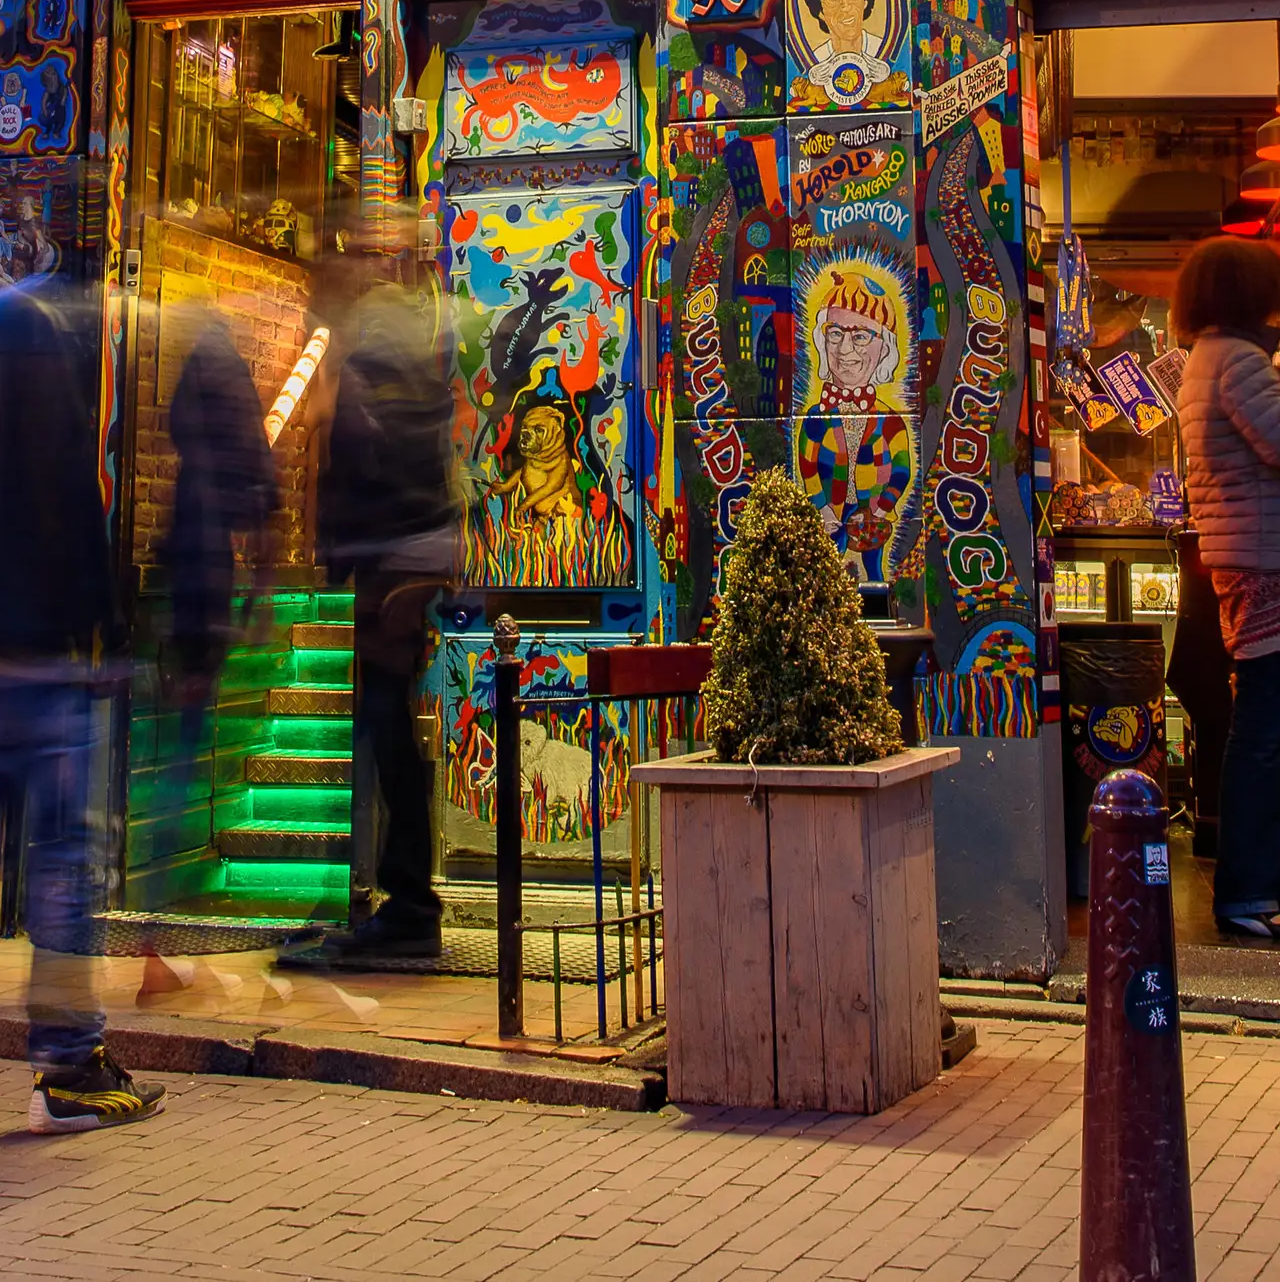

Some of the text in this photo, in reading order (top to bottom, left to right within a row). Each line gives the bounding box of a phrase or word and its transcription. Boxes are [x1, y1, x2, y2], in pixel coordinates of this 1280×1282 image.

[966, 69, 981, 86] This
[924, 97, 957, 114] PAINTED
[926, 102, 969, 141] AUSSIE
[800, 122, 899, 157] WORLD FAMOUS ART
[799, 157, 811, 175] BY
[840, 149, 905, 204] KANGAROO
[791, 222, 812, 238] Self
[819, 199, 910, 234] THORNTON
[502, 302, 539, 371] The CATS PYJAMAS
[935, 283, 1007, 590] BULLDOG
[1141, 971, 1162, 993] 家
[1148, 1007, 1168, 1028] 族
